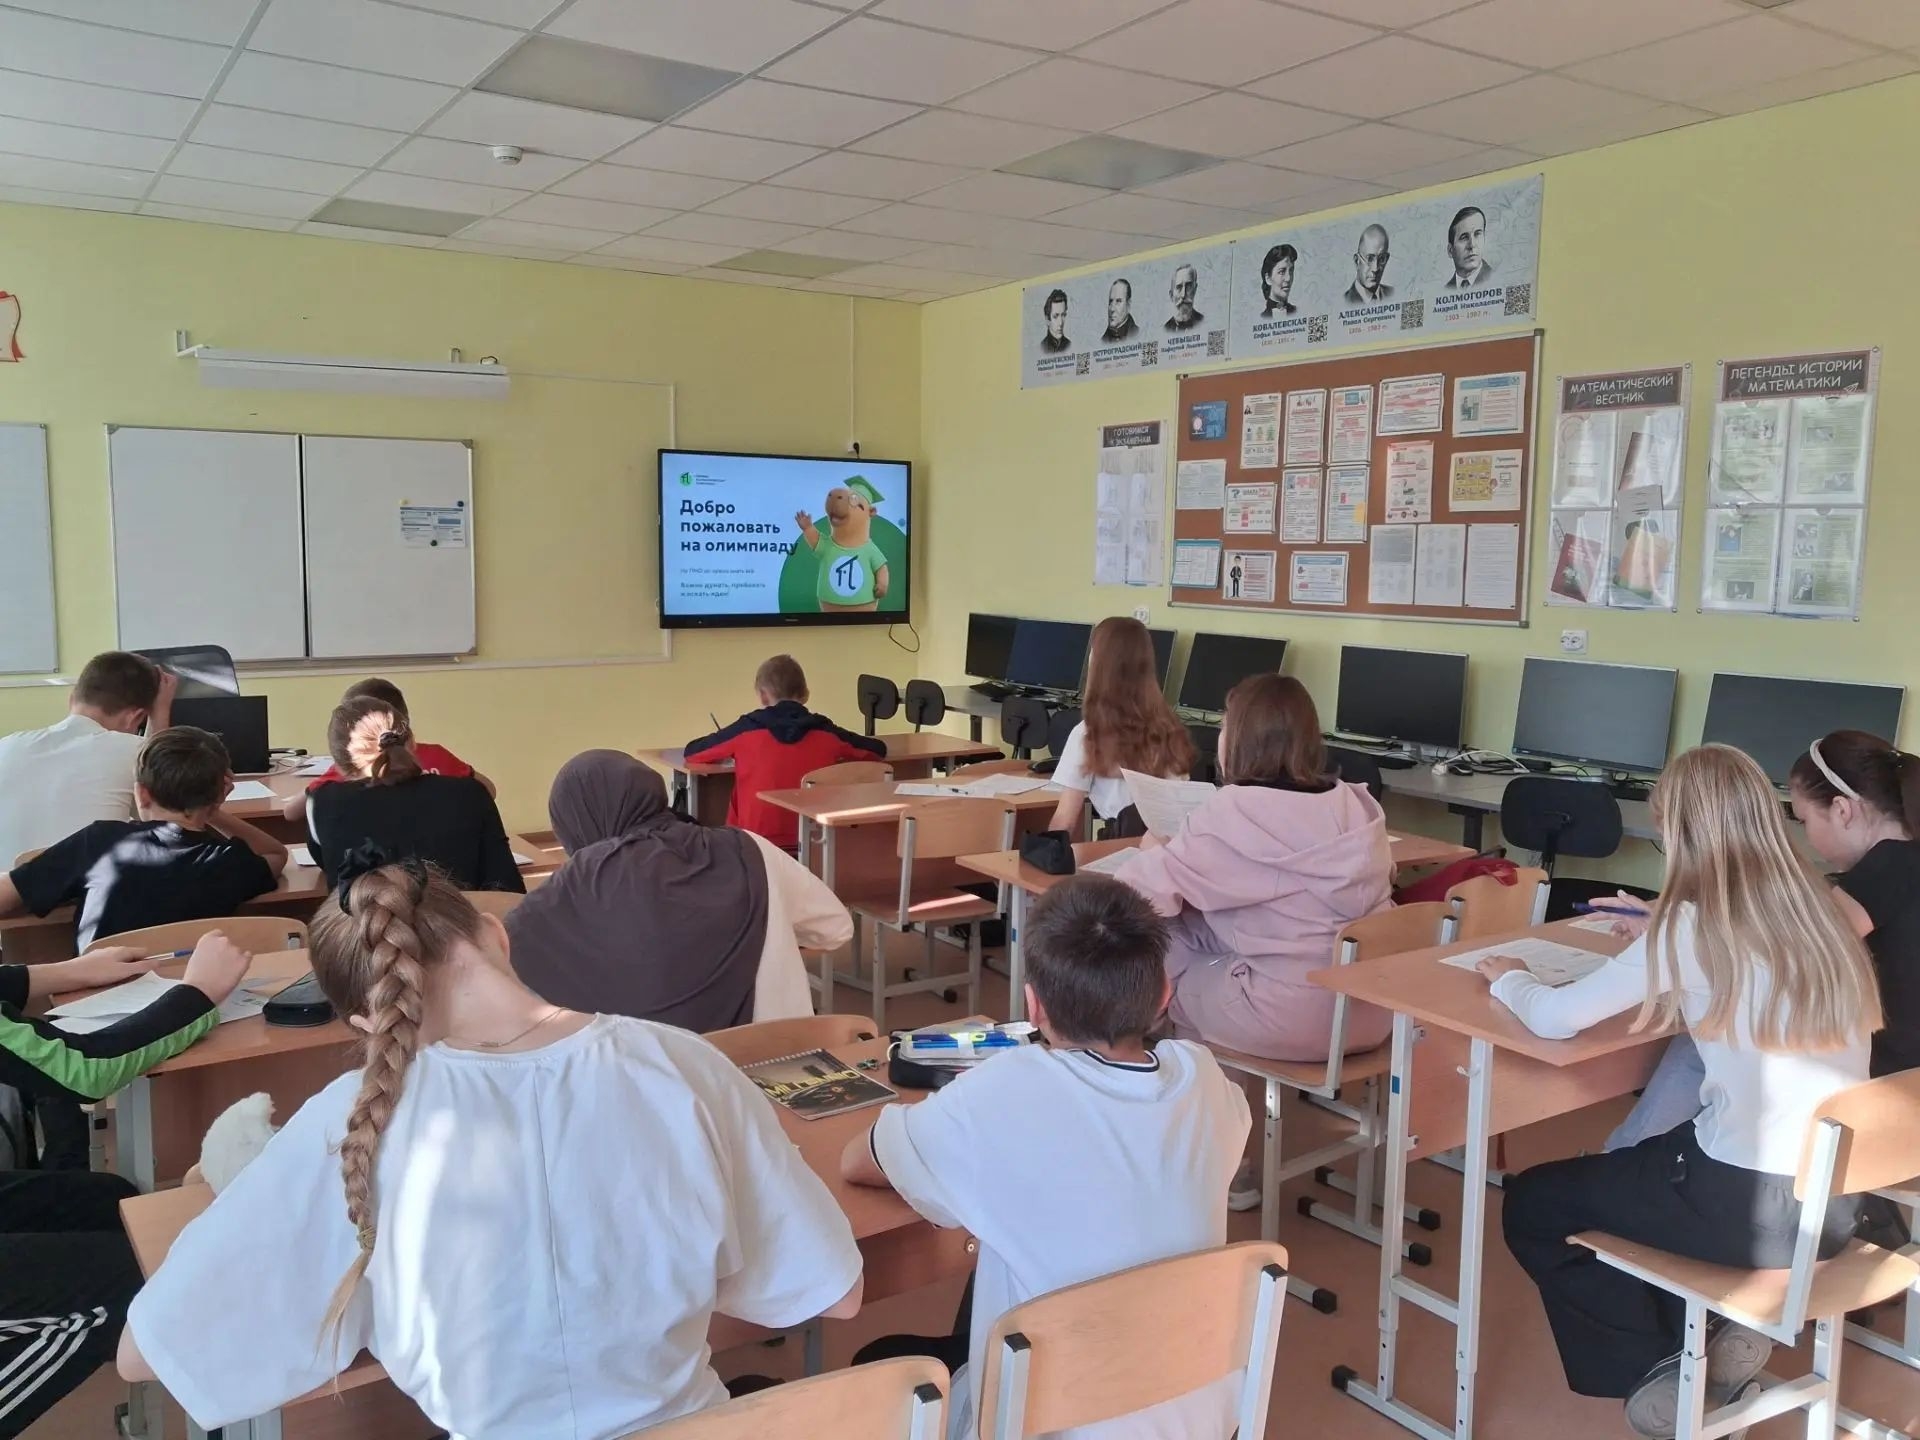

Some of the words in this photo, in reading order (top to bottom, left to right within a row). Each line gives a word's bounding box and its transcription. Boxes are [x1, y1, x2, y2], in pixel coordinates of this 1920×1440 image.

[1435, 288, 1503, 306] КОЛМОГОРОВ
[1338, 303, 1401, 320] АЛЕКСАНДРОВ
[1252, 317, 1307, 332] КОВАЛЕВСКАЯ
[1730, 364, 1795, 380] ЛЕГЕНДЫ
[1798, 359, 1863, 375] ИСТОРИИ
[1570, 373, 1674, 394] МАТЕМАТИЧЕСКИЙ
[1747, 376, 1841, 393] МАТЕМАТИКИ
[1595, 392, 1644, 405] ВЕСТНИК
[680, 499, 736, 517] Добро
[680, 521, 781, 534] пожаловать
[681, 541, 700, 552] на
[705, 541, 799, 556] олимпиаду
